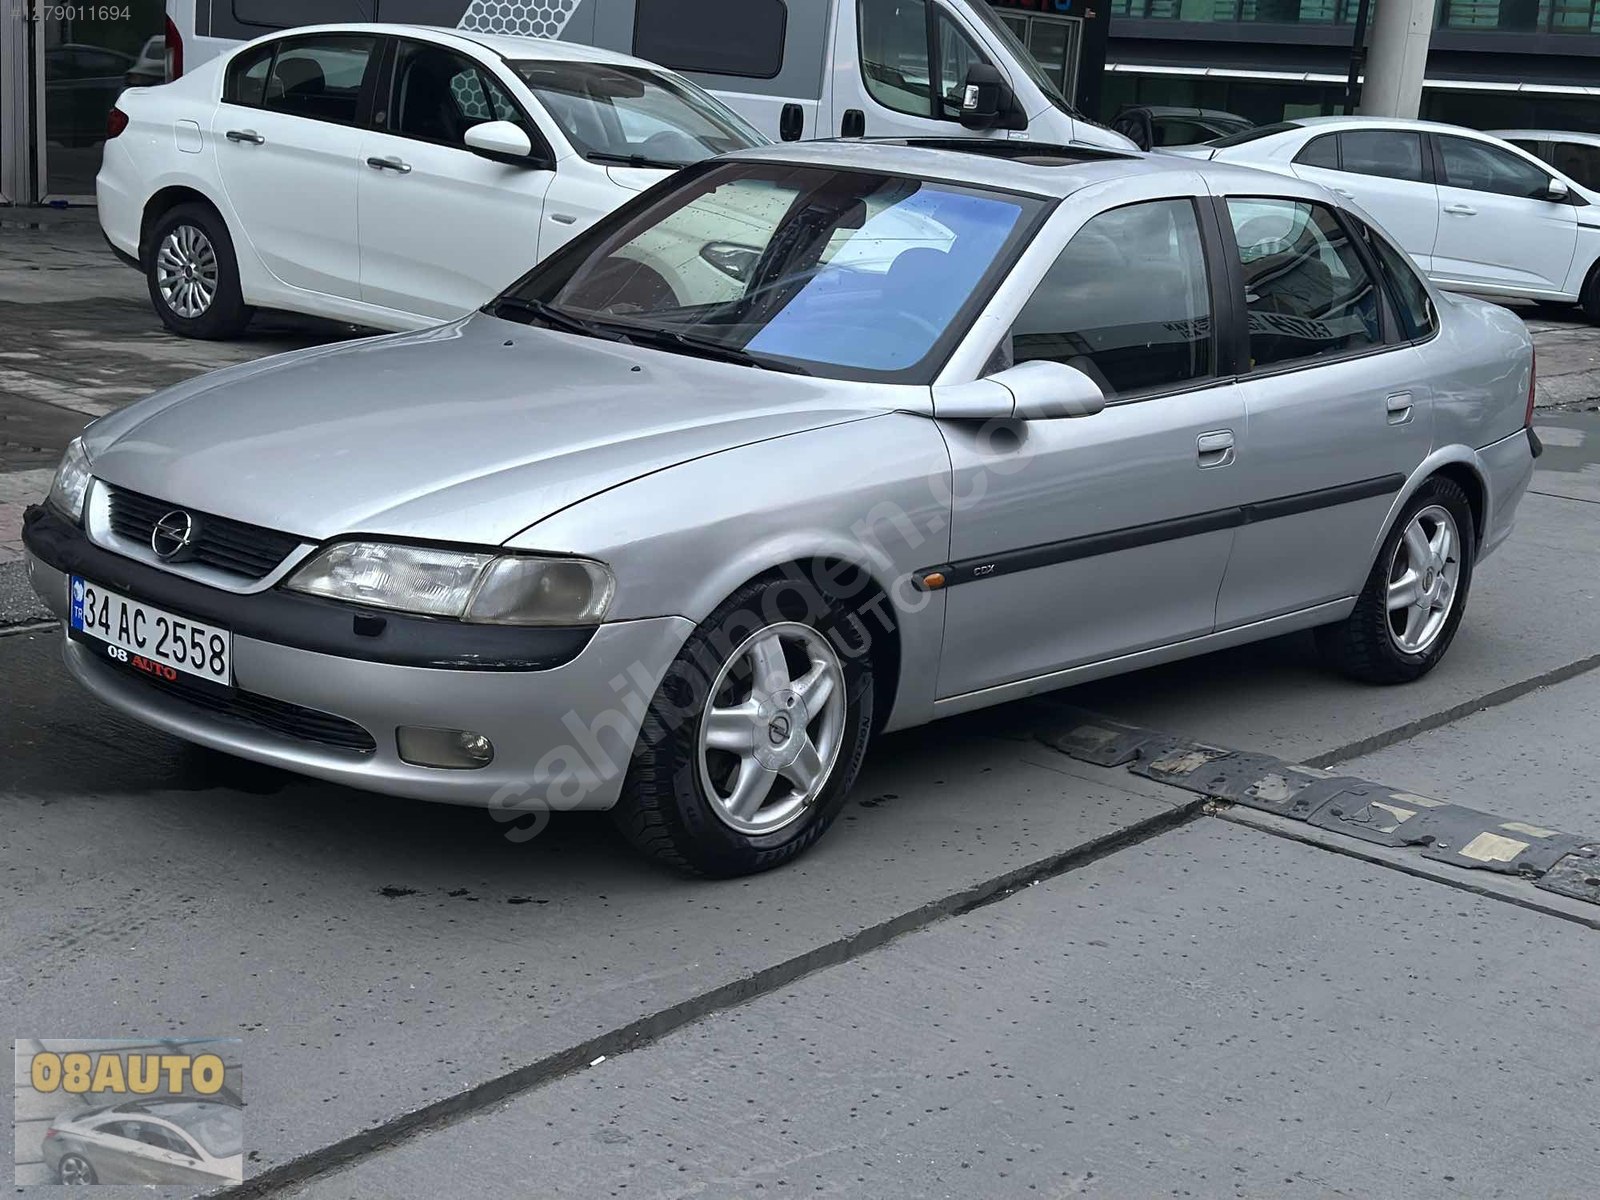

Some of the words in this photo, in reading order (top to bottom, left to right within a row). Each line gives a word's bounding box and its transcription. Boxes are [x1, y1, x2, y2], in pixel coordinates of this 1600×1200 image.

[973, 563, 995, 576] CDX
[74, 606, 83, 620] TR
[84, 588, 111, 636] 34
[118, 602, 147, 649] AC
[155, 616, 226, 676] 2558
[107, 645, 129, 663] 08
[131, 655, 177, 682] AUTO
